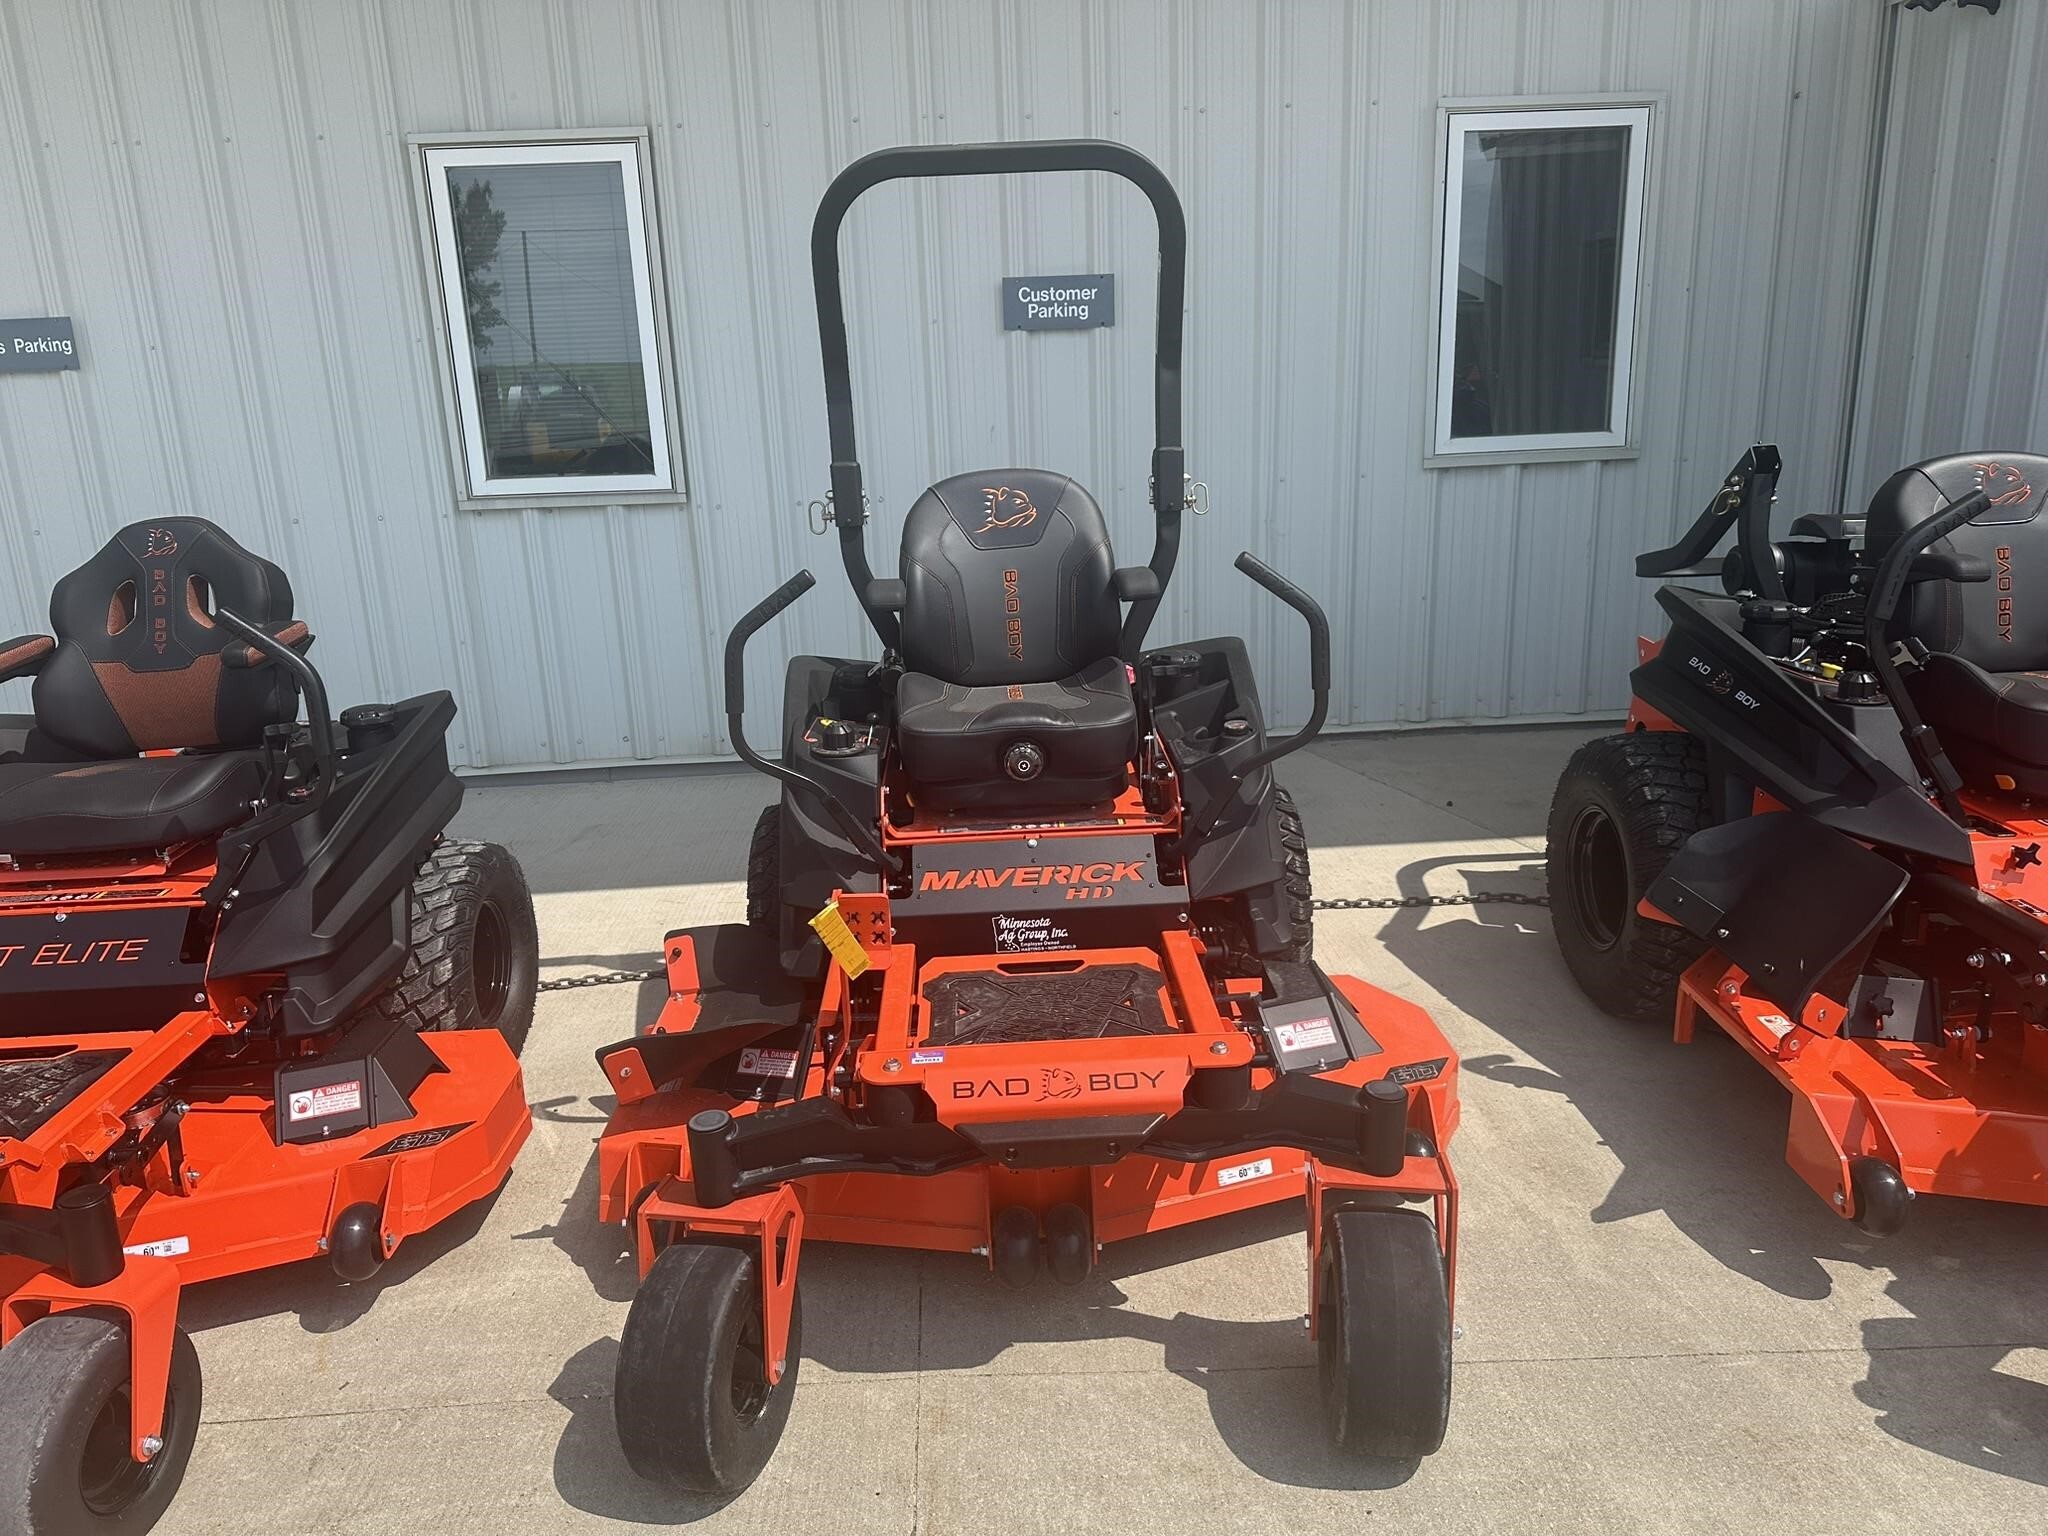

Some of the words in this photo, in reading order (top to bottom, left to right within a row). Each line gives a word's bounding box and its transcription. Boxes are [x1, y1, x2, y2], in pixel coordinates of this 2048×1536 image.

[1018, 286, 1098, 303] Customer
[1028, 302, 1089, 320] Parking
[13, 337, 73, 355] Parking
[1996, 547, 2011, 592] BAD
[153, 569, 167, 606] BAD
[1003, 569, 1019, 613] BAD
[1998, 597, 2012, 642] BOY
[153, 618, 167, 654] BOY
[1007, 618, 1023, 661] BOY
[1688, 656, 1711, 675] BAD
[1735, 690, 1760, 709] BOY
[919, 860, 1146, 892] MAVERICK
[1065, 885, 1114, 900] HD
[998, 917, 1051, 930] Minnesota
[998, 928, 1016, 943] Ag
[1017, 928, 1049, 942] Group,
[1051, 927, 1068, 938] Inc.
[31, 939, 149, 966] ELITE
[1303, 1019, 1330, 1030] DANGER
[770, 1050, 798, 1060] DANGER
[325, 1082, 358, 1095] DANGER
[953, 1078, 1030, 1099] BAD
[1089, 1070, 1165, 1092] BOY
